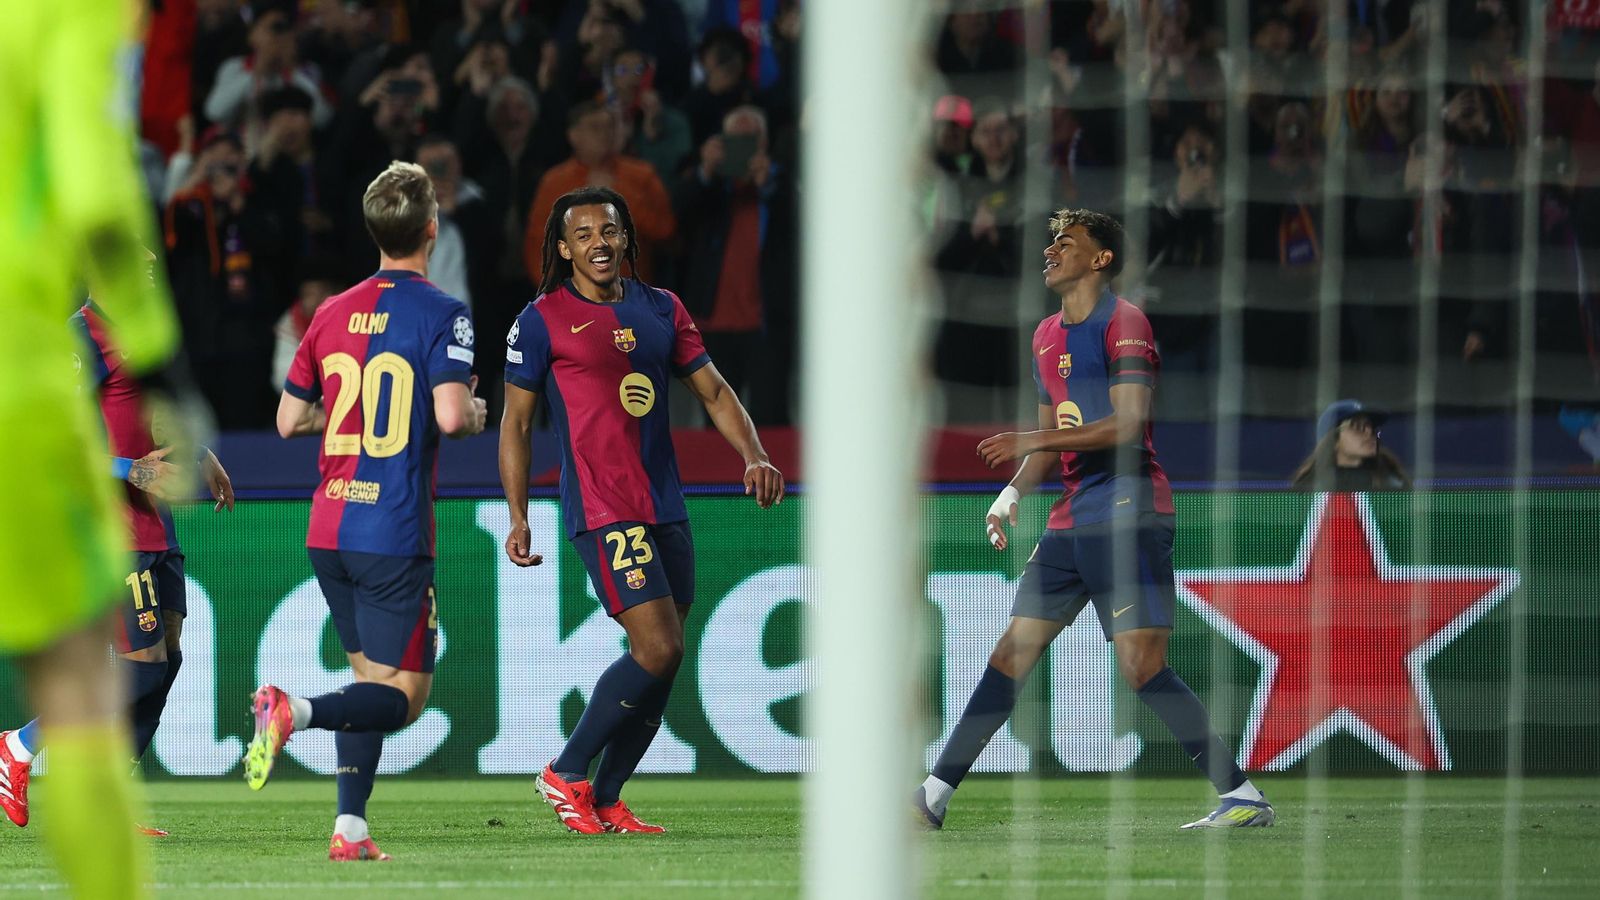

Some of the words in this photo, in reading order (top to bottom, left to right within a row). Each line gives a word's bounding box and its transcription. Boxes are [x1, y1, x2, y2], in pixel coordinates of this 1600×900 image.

[347, 312, 389, 334] OLMO
[1115, 339, 1148, 348] AMBILIGHT
[321, 351, 414, 458] 20
[605, 525, 653, 571] 23
[125, 569, 158, 610] 11
